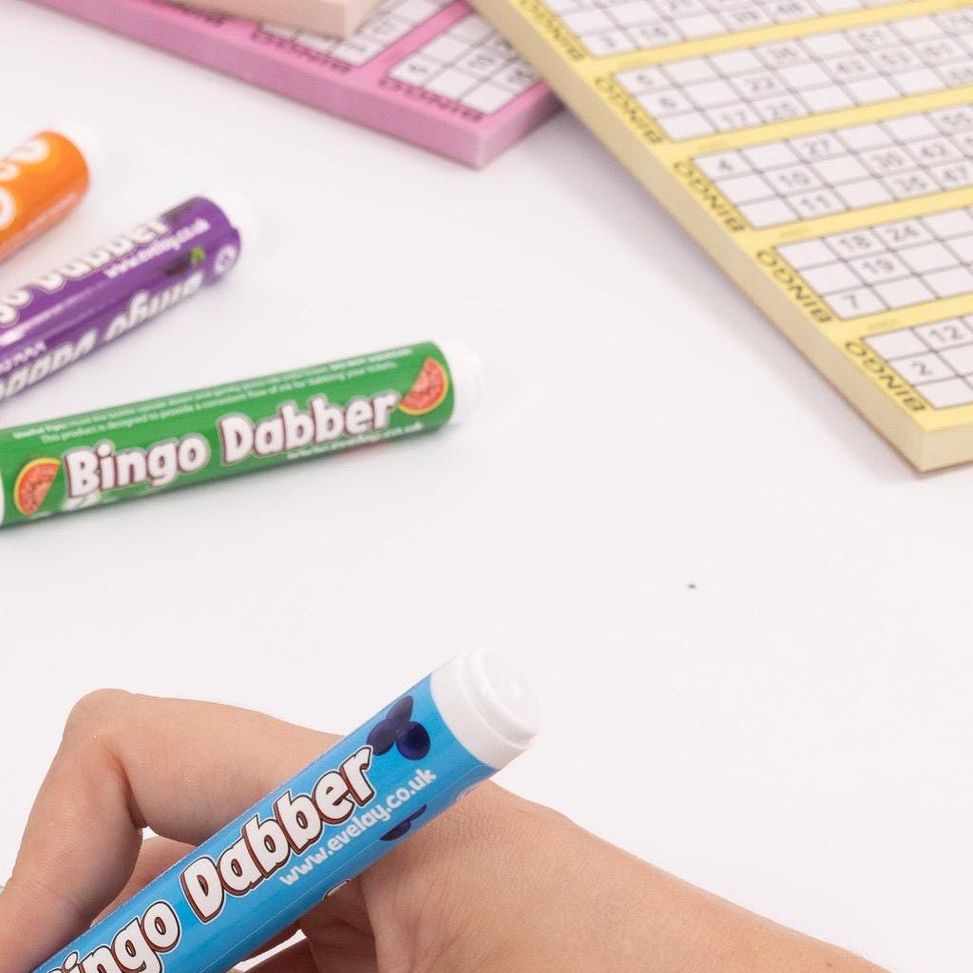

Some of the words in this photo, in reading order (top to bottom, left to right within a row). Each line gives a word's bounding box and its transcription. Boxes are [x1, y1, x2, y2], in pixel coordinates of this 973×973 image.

[756, 249, 832, 323] BINGO
[911, 361, 934, 376] 2
[930, 324, 966, 341] 12
[844, 340, 926, 412] BINGO
[61, 433, 211, 499] Bingo
[216, 390, 401, 465] Dabber
[181, 745, 374, 923] Dabber
[279, 767, 437, 888] www.evelay.co.uk
